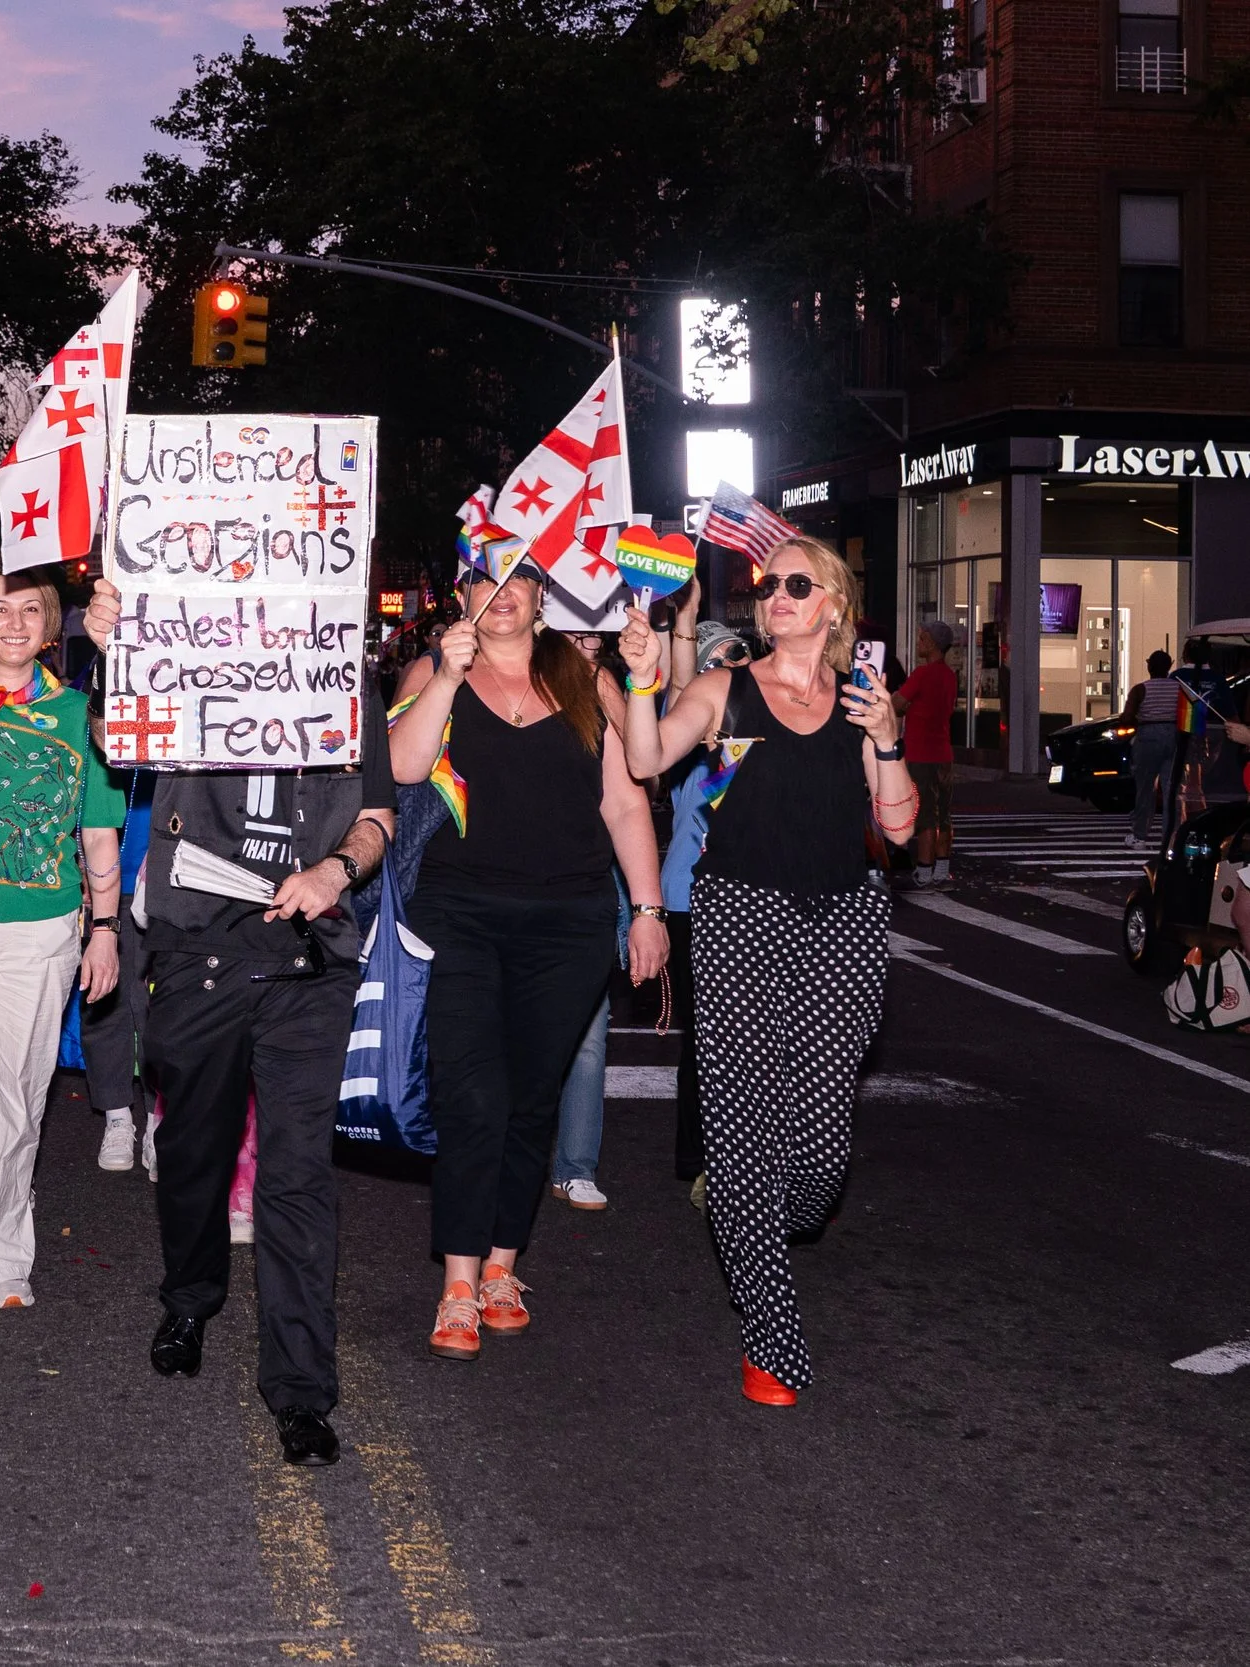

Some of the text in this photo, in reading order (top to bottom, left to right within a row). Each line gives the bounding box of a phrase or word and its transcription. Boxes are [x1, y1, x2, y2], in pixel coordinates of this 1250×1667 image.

[121, 420, 338, 486] Unsilenced
[899, 442, 977, 488] LaserAway
[782, 481, 829, 509] FRAMEBRIDGE
[113, 494, 356, 583] Georgians
[618, 550, 690, 580] LOVE WINS
[114, 593, 358, 652] Hardest border
[306, 661, 356, 693] was
[335, 1124, 380, 1135] OYAGERS
